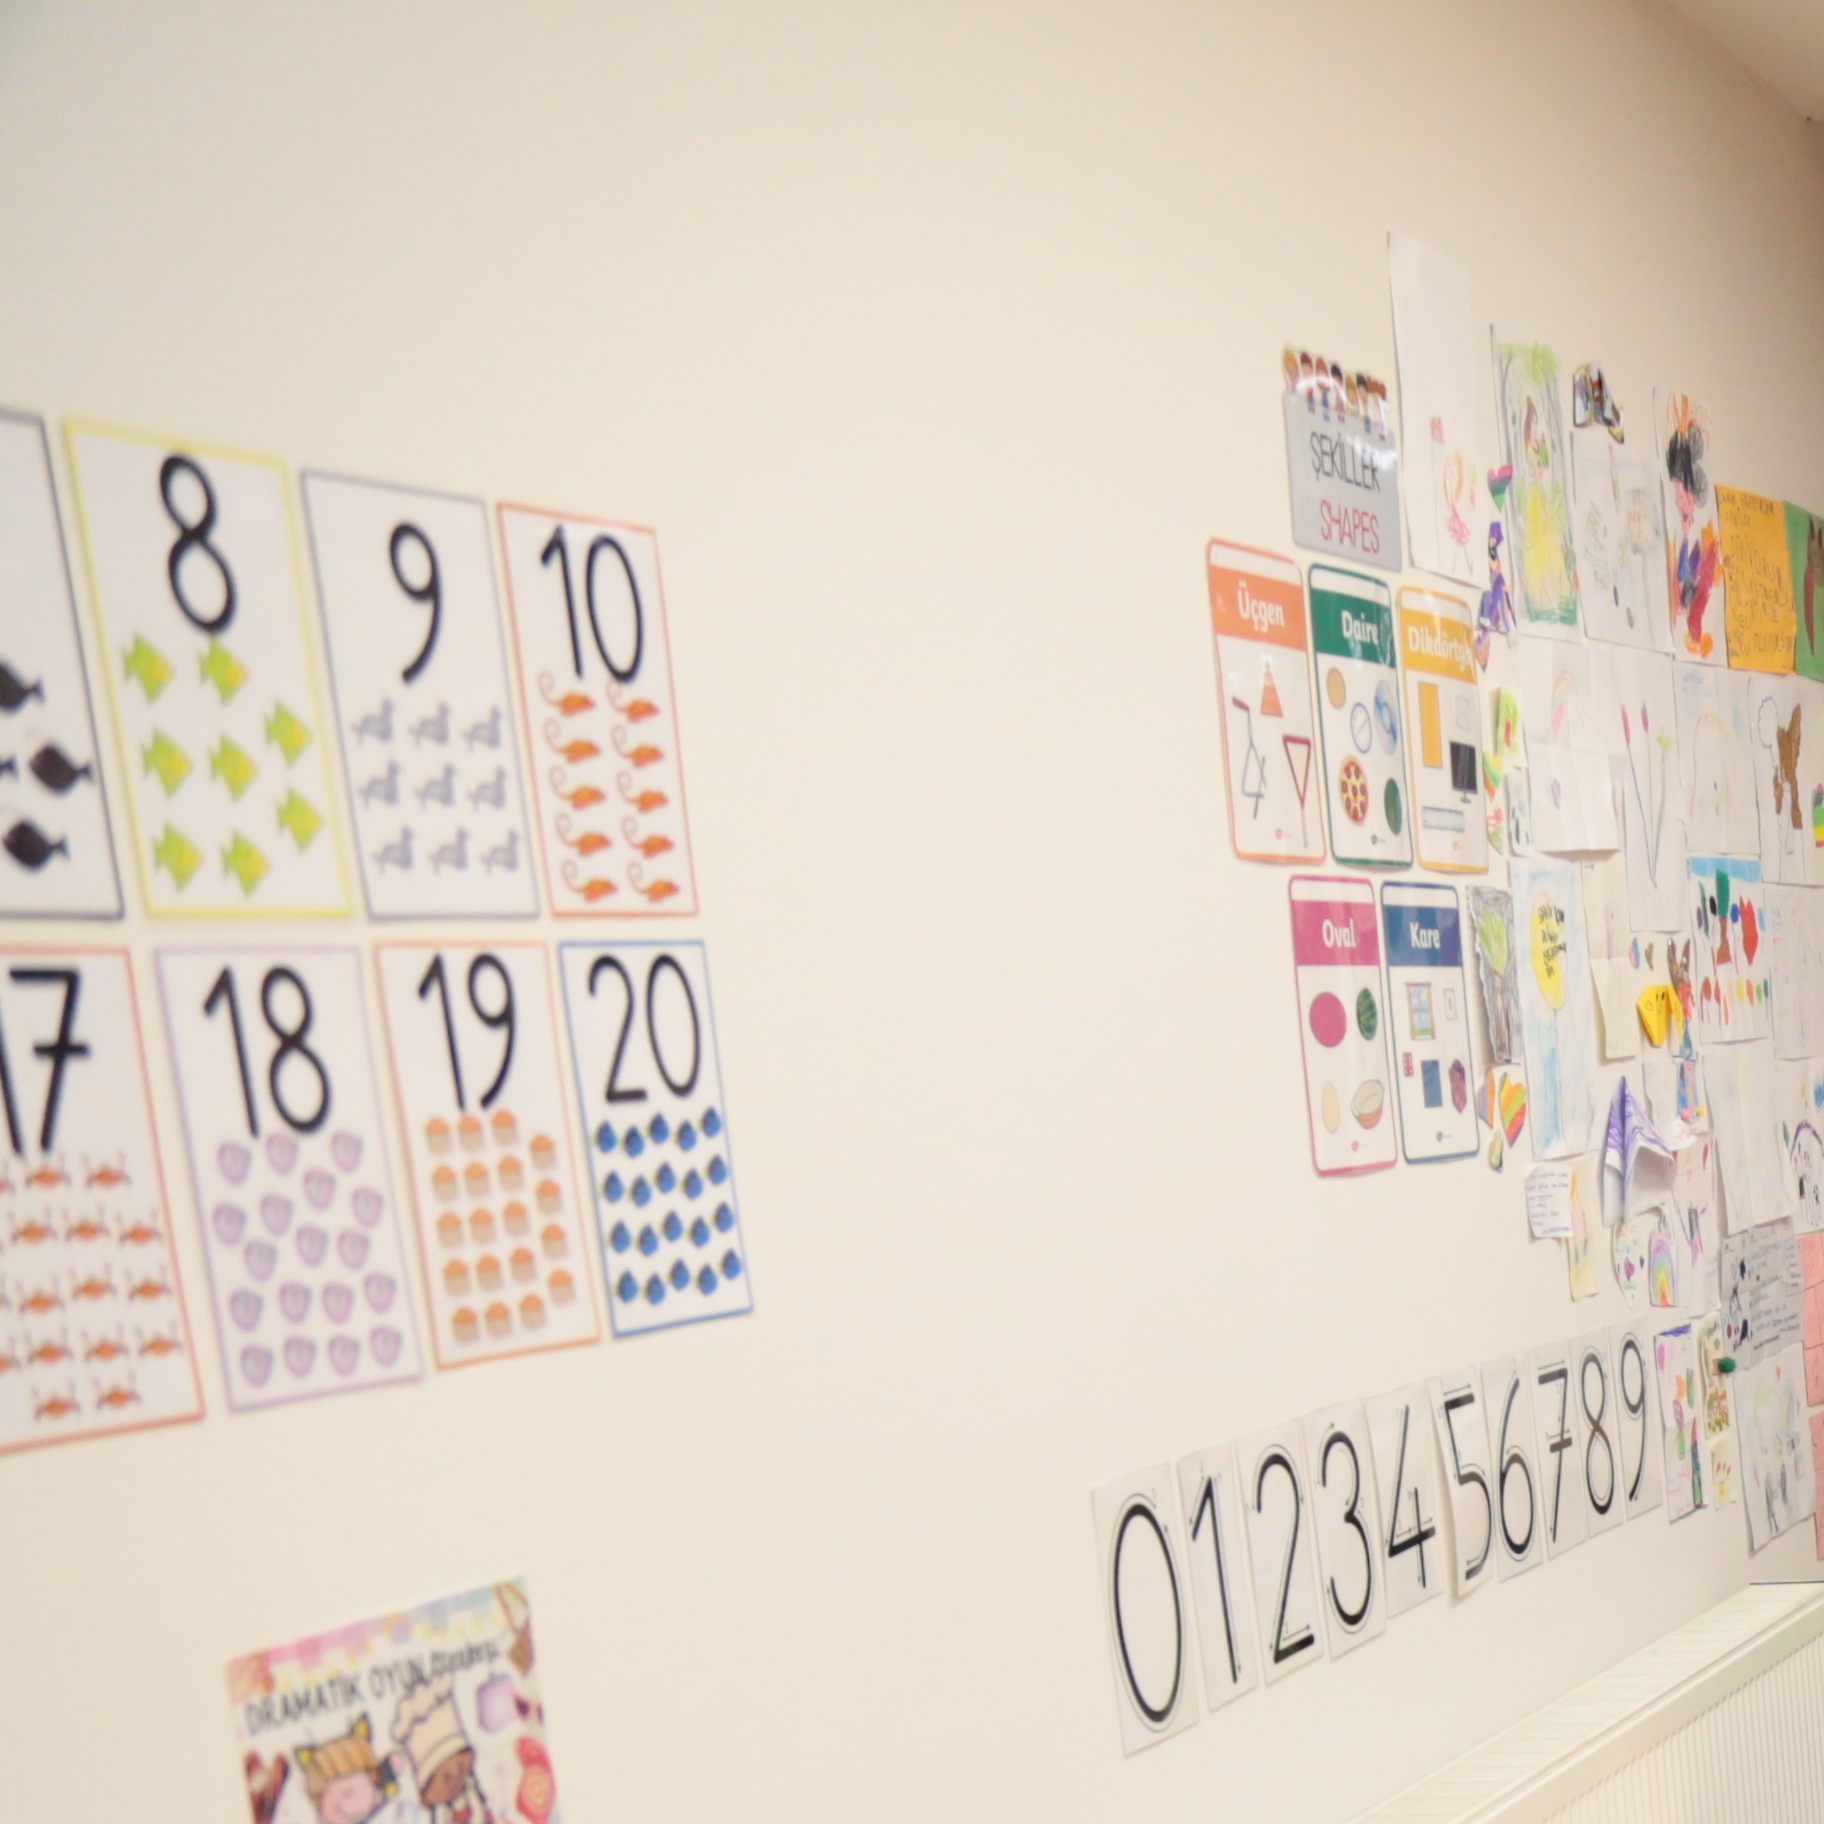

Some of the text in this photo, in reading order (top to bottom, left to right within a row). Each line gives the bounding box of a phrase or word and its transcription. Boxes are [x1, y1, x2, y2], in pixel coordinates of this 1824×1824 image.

[157, 454, 237, 636] 8
[1320, 499, 1381, 555] SHAPES
[386, 521, 442, 684] 9
[538, 524, 644, 684] 10
[1236, 579, 1286, 633] Üçgen
[1340, 609, 1379, 646] Daire
[1321, 917, 1357, 949] Oval
[1409, 921, 1441, 950] Kare
[202, 965, 331, 1136] 18
[417, 953, 516, 1111] 19
[587, 953, 701, 1103] 20
[1114, 1339, 1646, 1722] 0 1 2 3 4 5 6 7 8 9
[245, 1672, 366, 1737] DRAMATİK
[369, 1655, 431, 1701] OYUN
